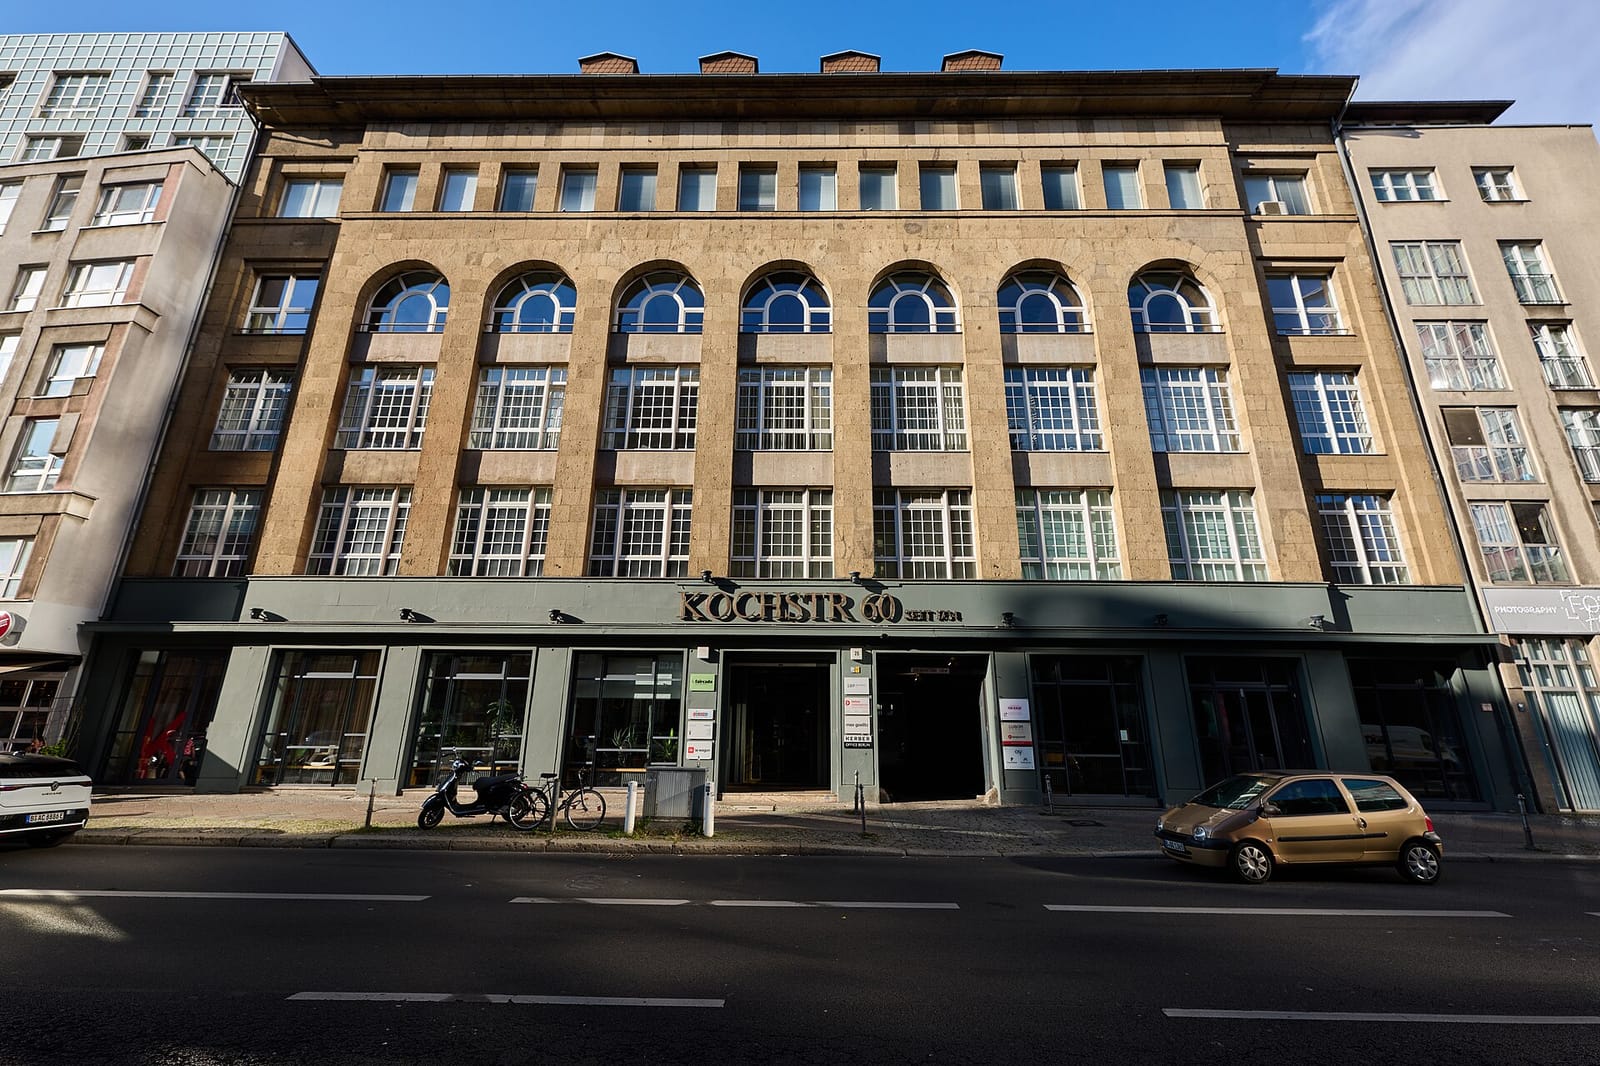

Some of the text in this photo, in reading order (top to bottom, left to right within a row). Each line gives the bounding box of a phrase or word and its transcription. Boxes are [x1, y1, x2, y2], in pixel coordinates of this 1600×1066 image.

[679, 591, 854, 622] KOCHSTR
[860, 592, 899, 622] 60
[1494, 606, 1557, 614] PHOTOGRAPHY
